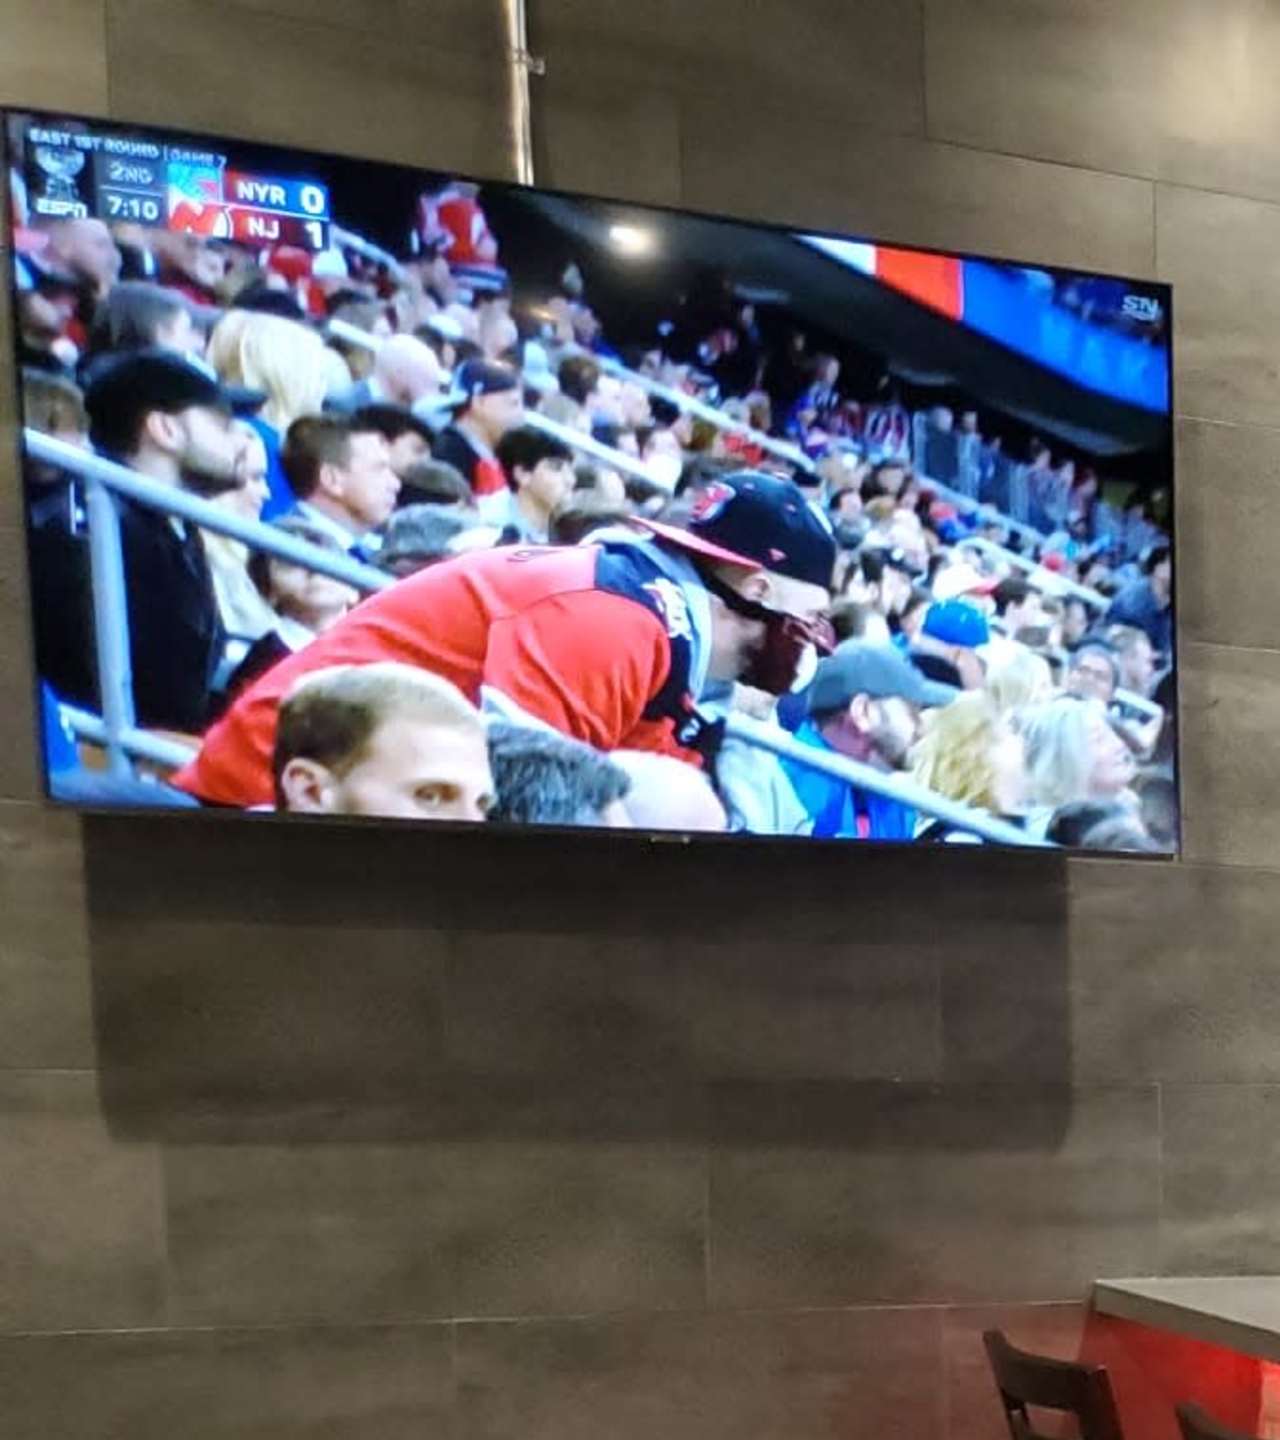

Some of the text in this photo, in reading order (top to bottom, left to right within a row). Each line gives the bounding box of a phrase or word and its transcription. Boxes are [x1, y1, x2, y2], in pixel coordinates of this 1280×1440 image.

[29, 128, 71, 147] EAST
[104, 138, 159, 158] ROUND
[109, 162, 152, 185] 2ND
[36, 199, 87, 219] ESPN
[108, 196, 158, 221] 7:10
[237, 181, 325, 215] NYR 0
[249, 217, 323, 248] NJ 1
